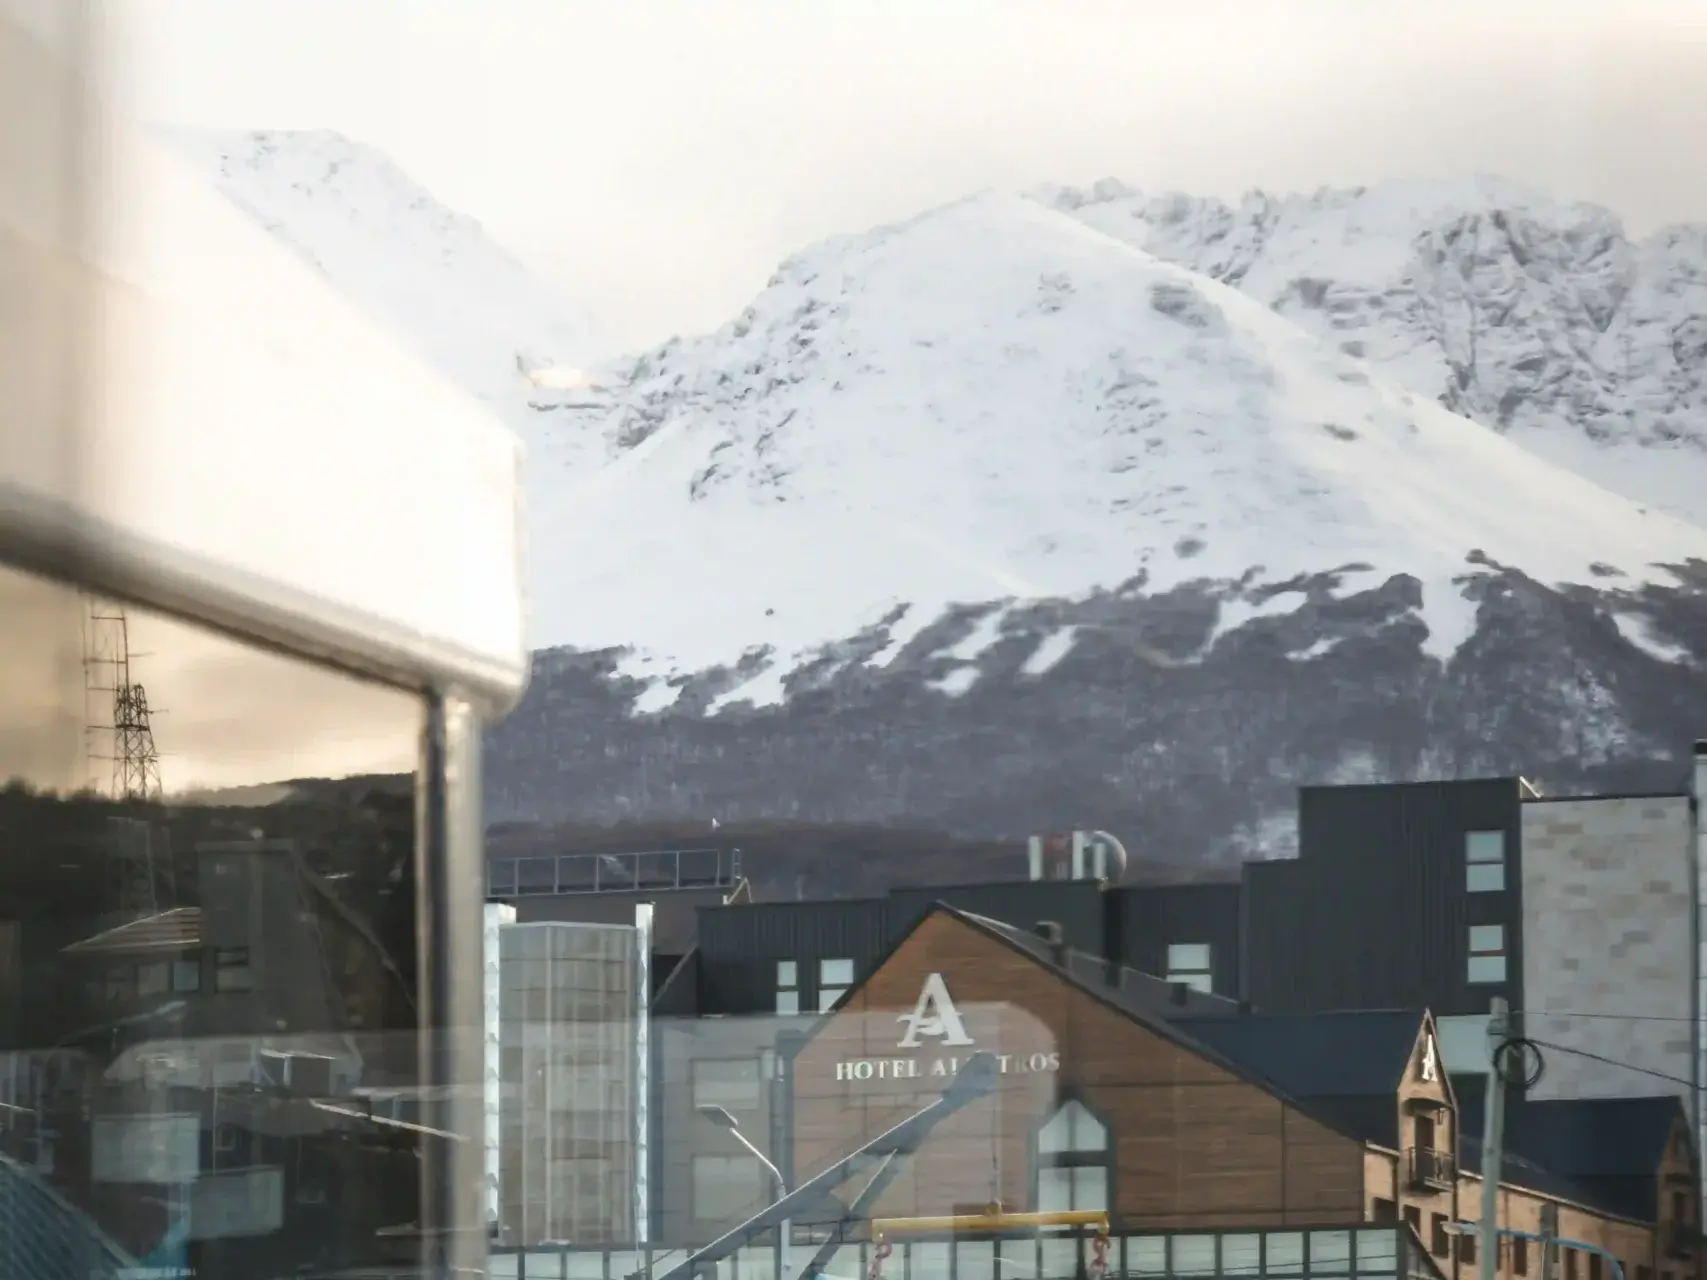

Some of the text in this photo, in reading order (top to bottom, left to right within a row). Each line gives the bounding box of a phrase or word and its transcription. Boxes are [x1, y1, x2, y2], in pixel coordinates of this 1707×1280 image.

[897, 973, 975, 1048] A
[836, 1052, 1060, 1081] HOTEL ALTROS
